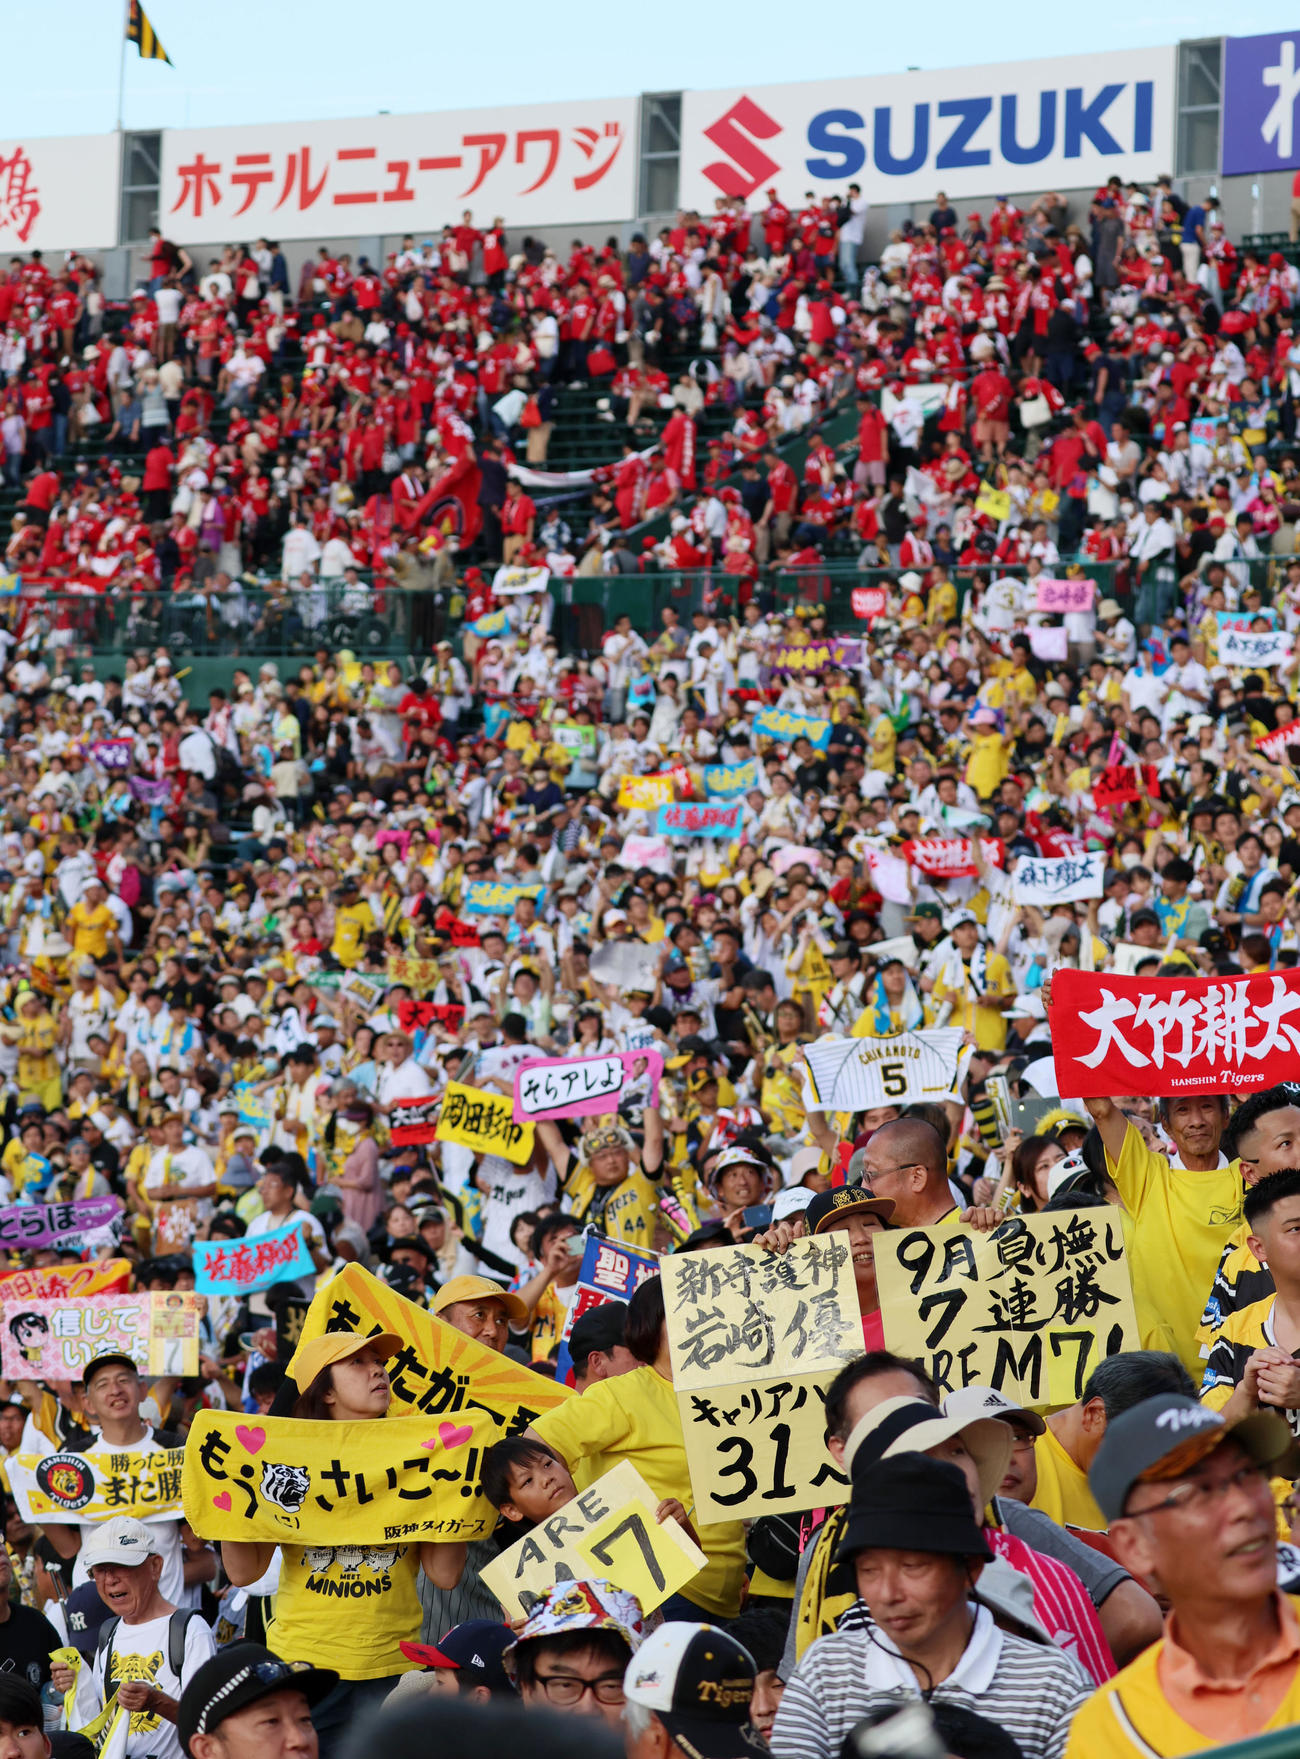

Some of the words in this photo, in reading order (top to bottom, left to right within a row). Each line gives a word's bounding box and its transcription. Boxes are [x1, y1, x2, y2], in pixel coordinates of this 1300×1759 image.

[806, 81, 1154, 180] SUZUKI
[171, 121, 624, 218] ホテルニューアワジ
[1072, 976, 1300, 1070] 大竹耕太
[858, 1046, 921, 1065] CHIKAMOTO
[523, 1062, 615, 1103] そらアレよ
[881, 1063, 908, 1097] 5
[1171, 1076, 1217, 1087] HANSHIN
[1220, 1070, 1265, 1087] Tigers
[624, 1216, 647, 1233] 44
[673, 1235, 849, 1313] 新守護神
[52, 1306, 141, 1337] 信じて
[918, 1264, 1122, 1350] 7連勝
[677, 1288, 867, 1371] 岩崎優
[41, 1455, 86, 1472] HANSHIN
[199, 1430, 258, 1519] もう
[50, 1491, 90, 1508] Tigers
[384, 1519, 486, 1540] 阪神タイガース
[515, 1489, 610, 1579] ARE
[305, 1575, 392, 1598] MINIONS
[698, 1680, 753, 1709] Tiger
